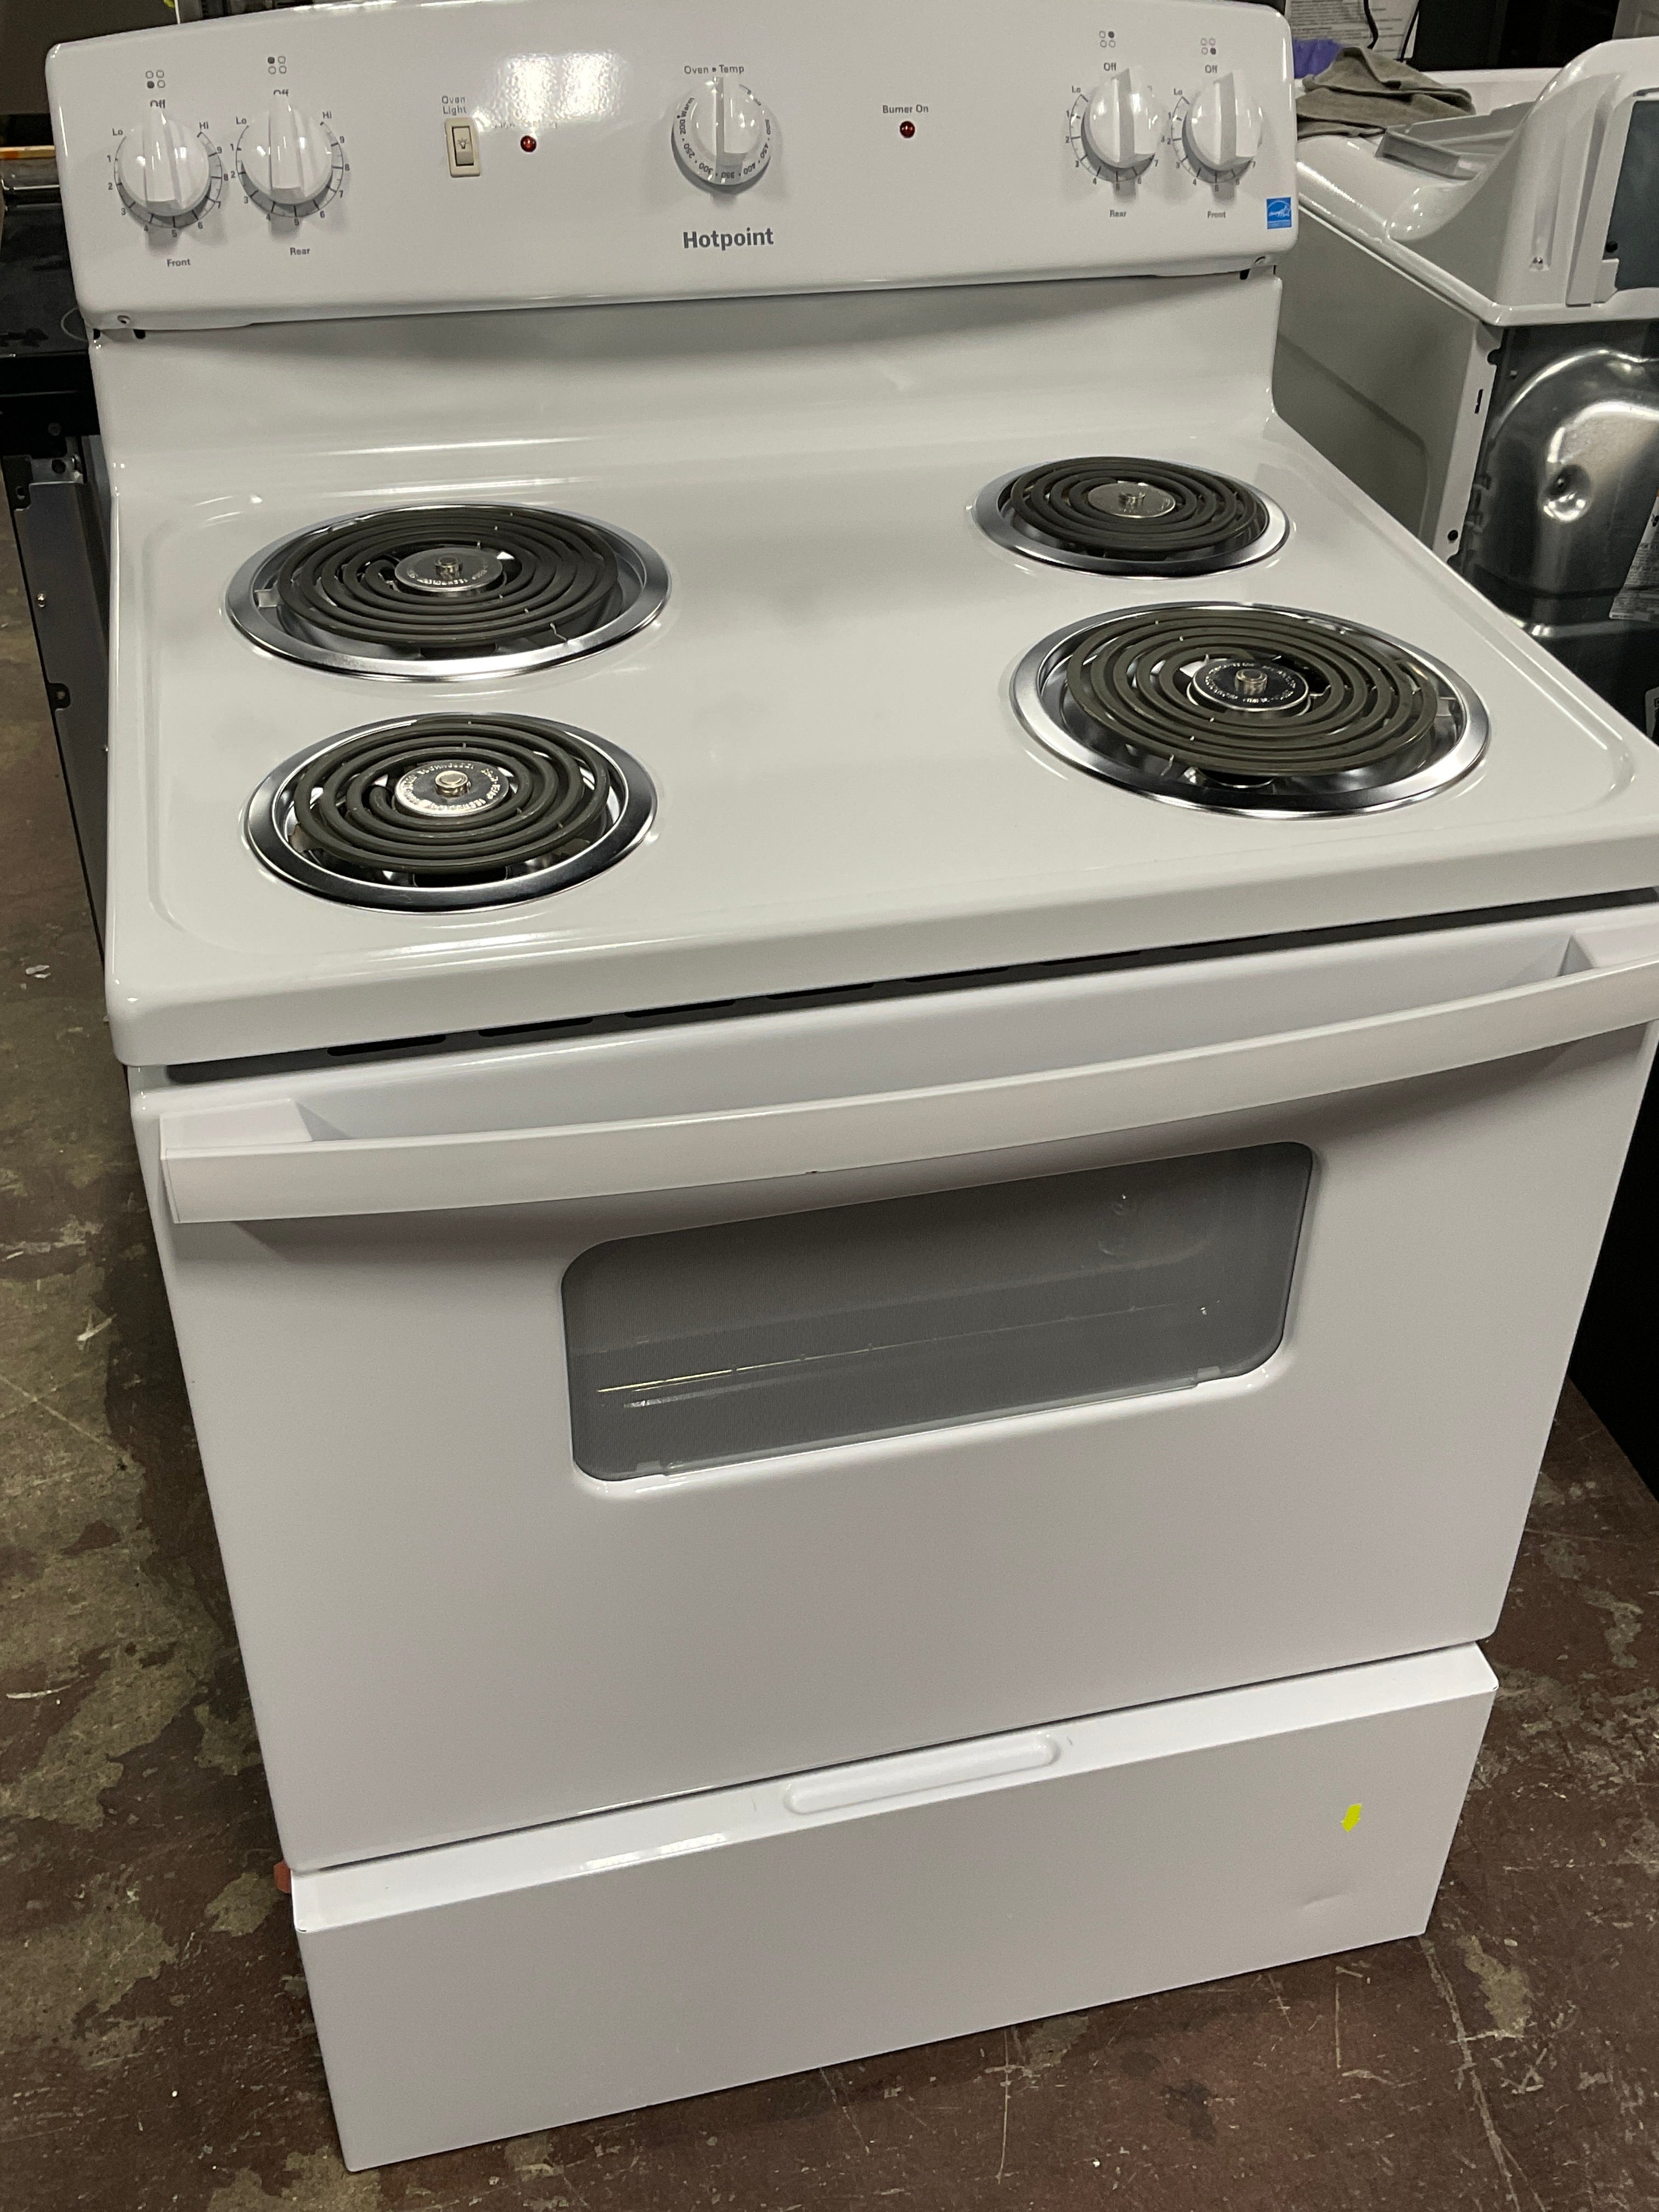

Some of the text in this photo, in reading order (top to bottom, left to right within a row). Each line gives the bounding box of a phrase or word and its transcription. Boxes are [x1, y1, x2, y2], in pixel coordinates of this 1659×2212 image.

[684, 64, 744, 75] Oven Temp
[1103, 62, 1117, 71] Off
[1205, 64, 1218, 74] Off
[150, 99, 166, 108] Off
[442, 95, 466, 104] Oven
[443, 106, 467, 116] Light
[882, 104, 929, 114] Burner On
[323, 111, 332, 119] Hi
[199, 121, 209, 129] Hi
[236, 116, 247, 125] Lo
[340, 136, 345, 144] 9
[1066, 110, 1070, 118] 1
[1154, 159, 1159, 167] 7
[684, 143, 695, 159] 250
[699, 162, 714, 174] 300
[743, 162, 756, 175] 400
[760, 142, 769, 159] 450
[339, 190, 344, 198] 7
[216, 201, 222, 209] 7
[121, 207, 126, 216] 3
[171, 229, 178, 238] 5
[683, 227, 774, 251] Hotpoint
[290, 247, 310, 256] Rear
[167, 258, 190, 267] Front
